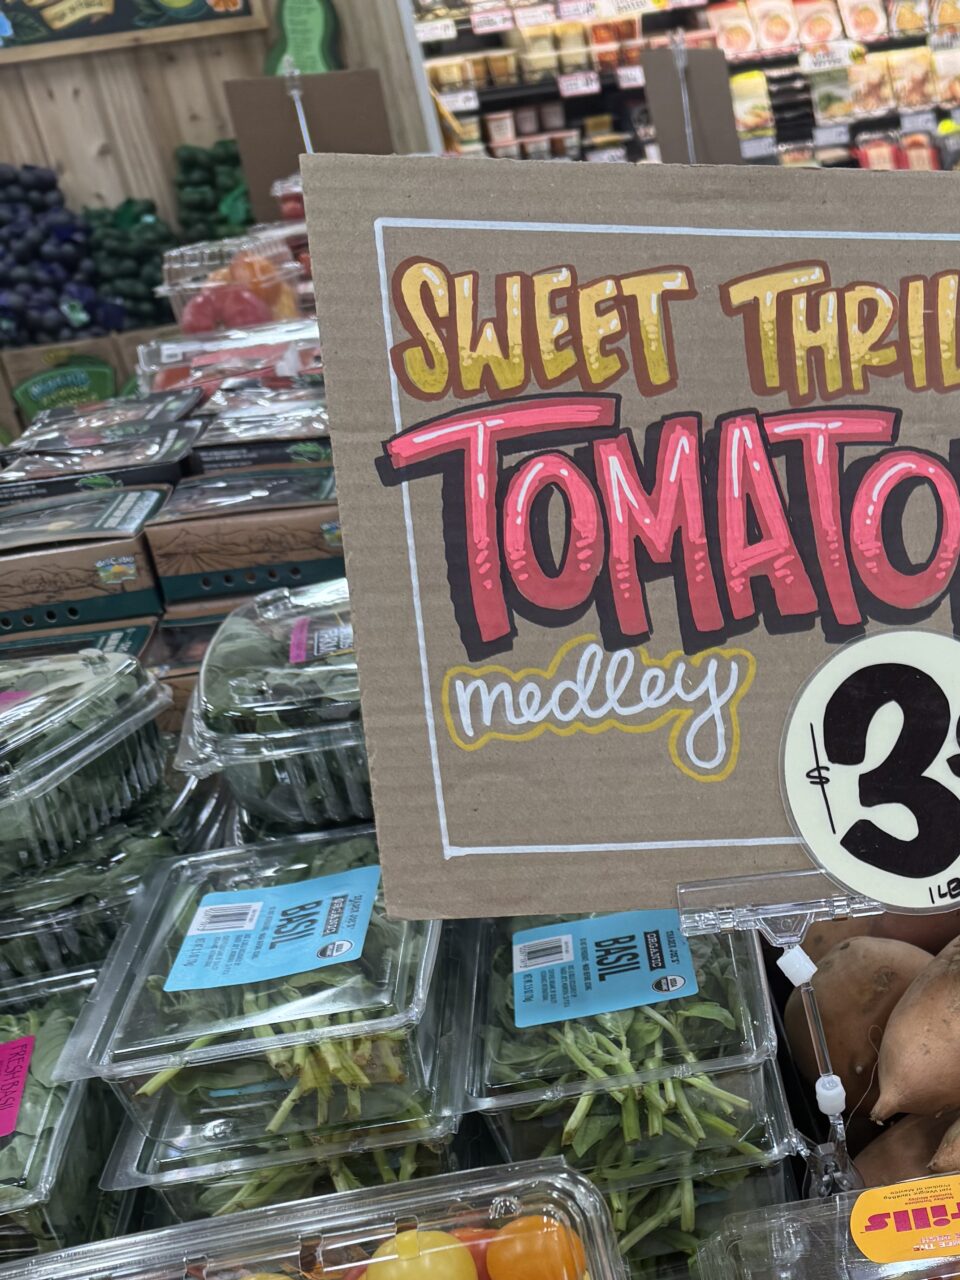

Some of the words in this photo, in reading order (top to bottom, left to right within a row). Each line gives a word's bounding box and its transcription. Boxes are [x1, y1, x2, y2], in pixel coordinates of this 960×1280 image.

[392, 258, 696, 400] SWEET
[453, 646, 738, 769] medley
[269, 901, 324, 950] BASIL
[594, 934, 641, 983] BASIL
[646, 932, 663, 969] ORGANIC
